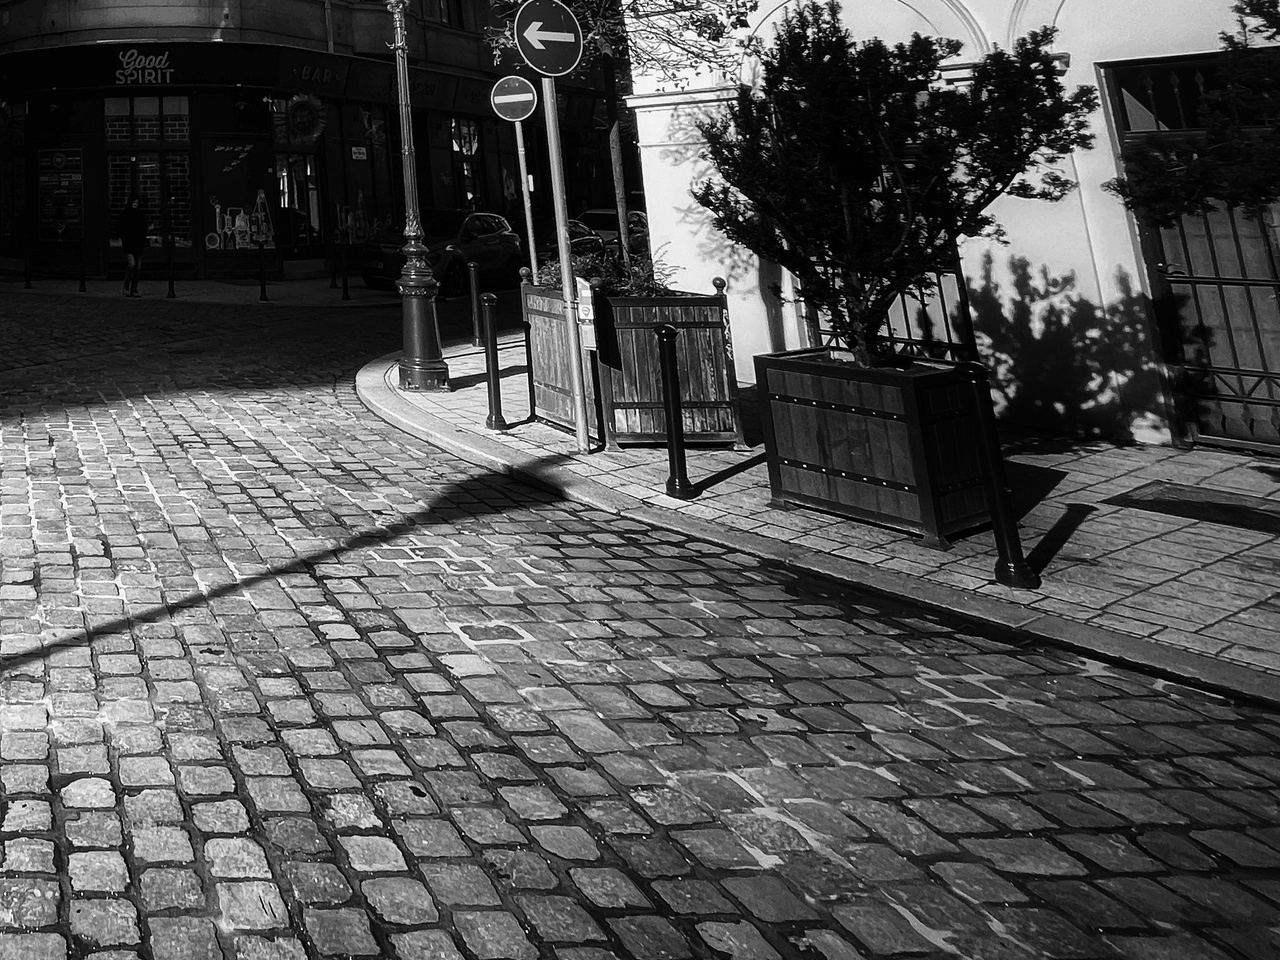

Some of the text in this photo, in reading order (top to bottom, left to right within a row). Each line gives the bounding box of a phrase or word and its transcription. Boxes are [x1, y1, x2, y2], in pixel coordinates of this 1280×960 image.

[119, 49, 170, 74] Good
[116, 68, 175, 84] SPIRIT
[301, 65, 332, 83] BAR
